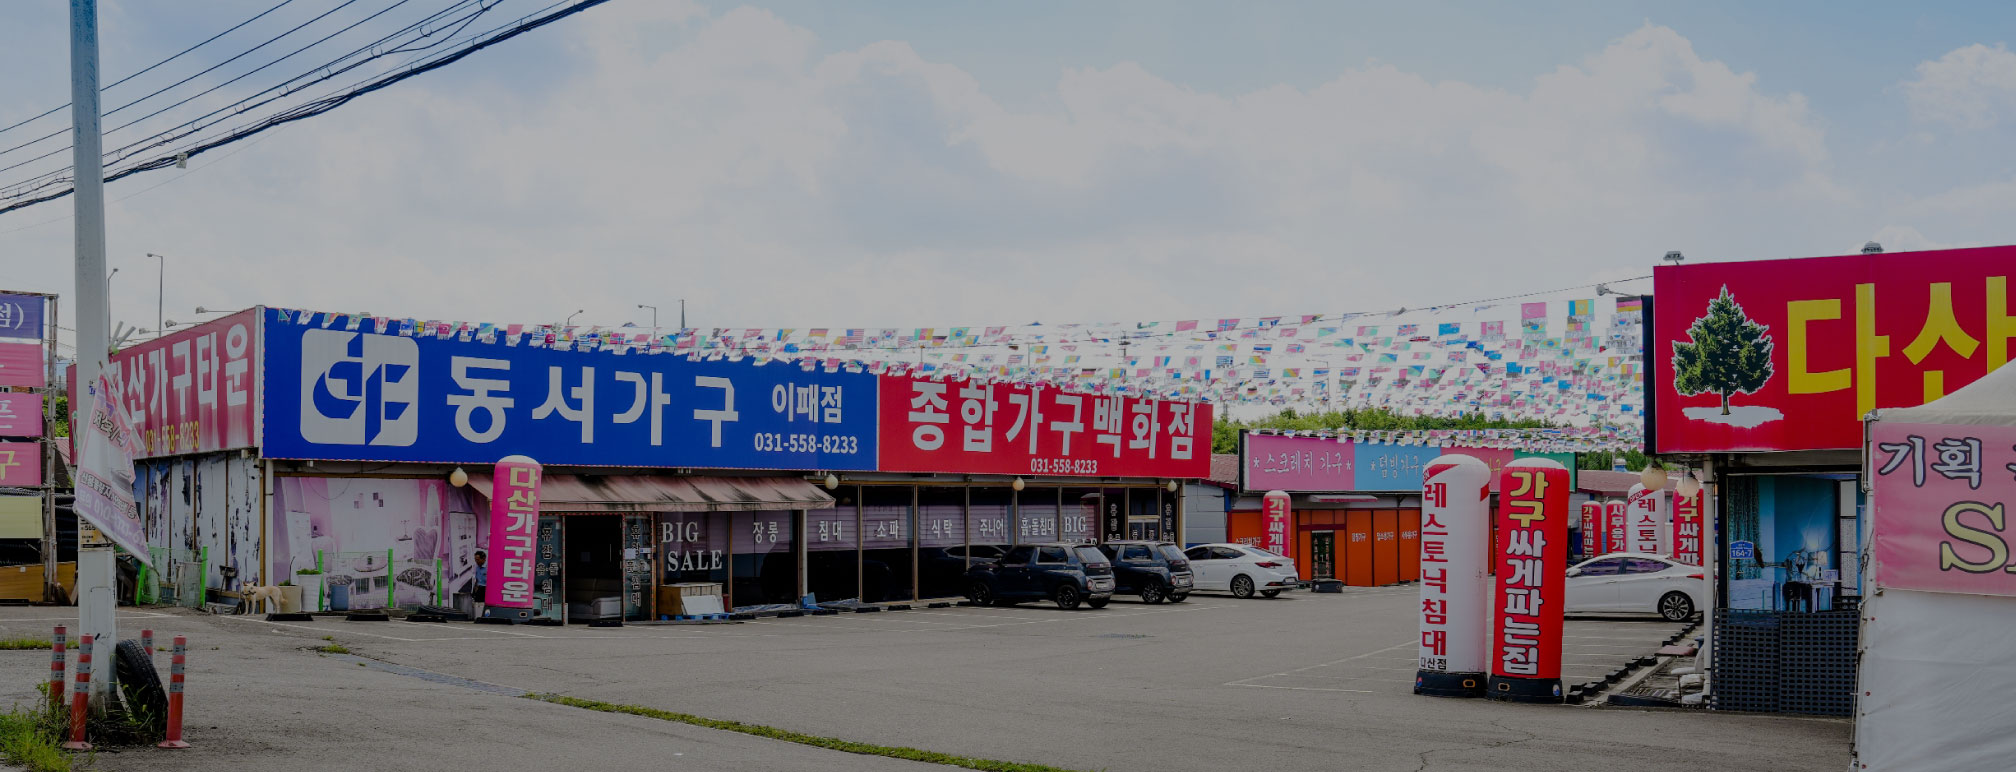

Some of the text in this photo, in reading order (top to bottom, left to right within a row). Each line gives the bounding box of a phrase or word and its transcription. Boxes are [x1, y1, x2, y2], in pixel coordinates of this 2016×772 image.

[447, 355, 739, 448] 동서가구
[771, 382, 843, 424] 이패점
[908, 381, 1195, 460] 종합가구백화점
[754, 432, 858, 455] 031-558-8233
[1030, 458, 1098, 475] 031-558-8233
[1319, 450, 1343, 476] 가구
[1878, 434, 1982, 490] 기획
[501, 467, 538, 603] 다산가구타운
[661, 521, 700, 543] BIG
[752, 521, 779, 543] 장롱
[819, 520, 843, 541] 침대
[876, 519, 900, 540] 소파
[931, 519, 953, 539] 식탁
[980, 518, 1004, 537] 주니어
[1065, 516, 1087, 533] BIG
[1611, 504, 1625, 554] 사무용가
[1940, 501, 2016, 576] S
[667, 549, 723, 572] SALE
[1731, 549, 1752, 557] 164-7
[1422, 482, 1448, 656] 레스토닉침대
[1502, 471, 1549, 675] 가구싸게파는집
